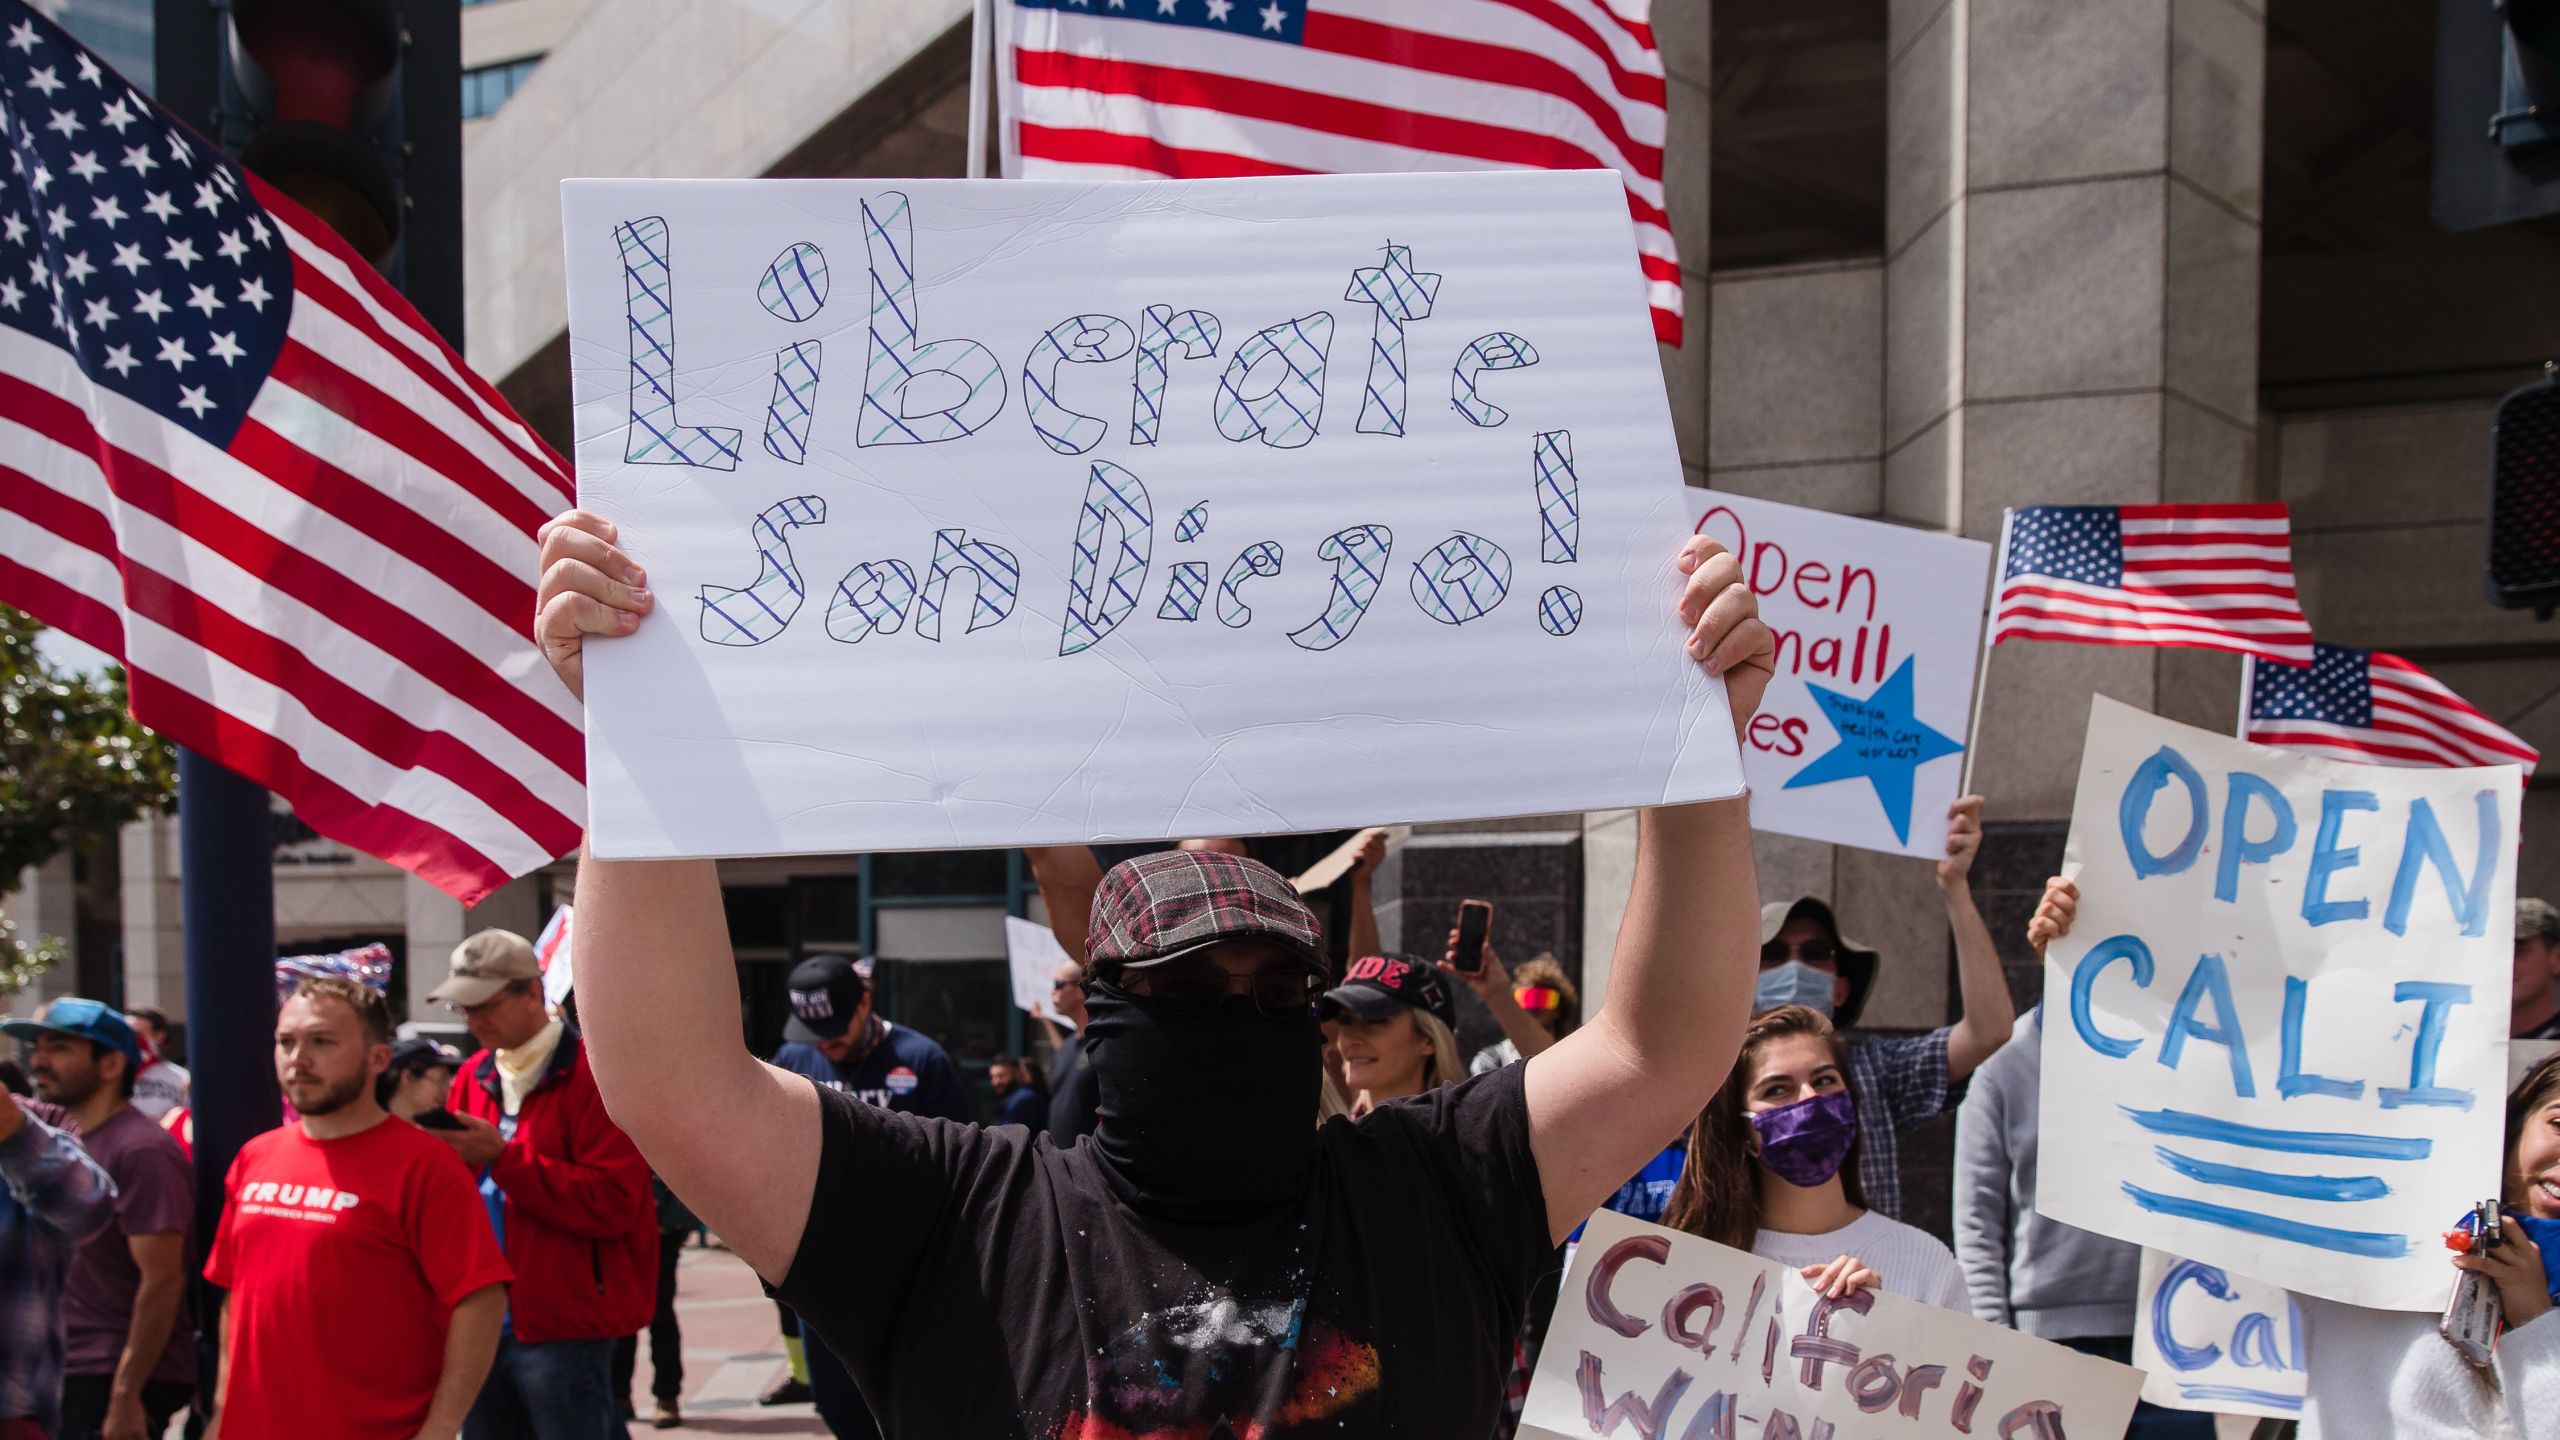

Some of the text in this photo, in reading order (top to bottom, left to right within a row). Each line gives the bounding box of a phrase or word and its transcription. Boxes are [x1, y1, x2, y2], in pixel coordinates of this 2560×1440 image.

[611, 190, 1540, 472] Liberate
[696, 430, 1583, 657] San Diego!
[1768, 625, 1891, 684] mall
[2119, 744, 2500, 938] OPEN
[2070, 934, 2477, 1110] CALI
[241, 1182, 360, 1212] TRUMP
